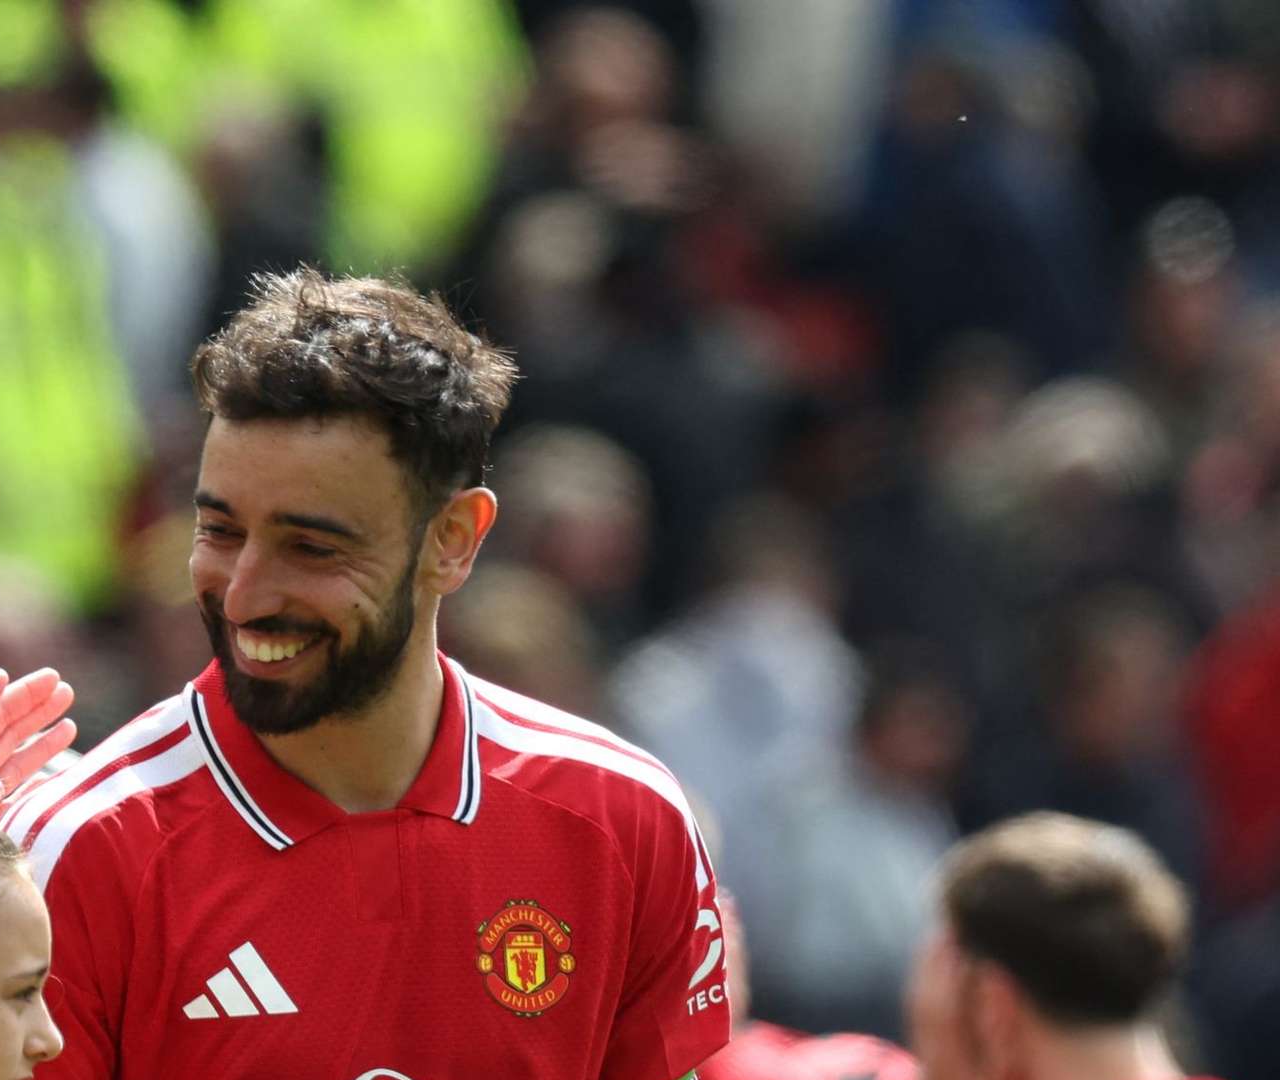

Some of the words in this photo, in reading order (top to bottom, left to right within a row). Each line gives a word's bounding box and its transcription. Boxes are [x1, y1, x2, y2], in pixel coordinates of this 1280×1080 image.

[485, 909, 564, 945] MANCHESTER
[501, 989, 556, 1009] UNITED
[687, 981, 729, 1016] TEC
